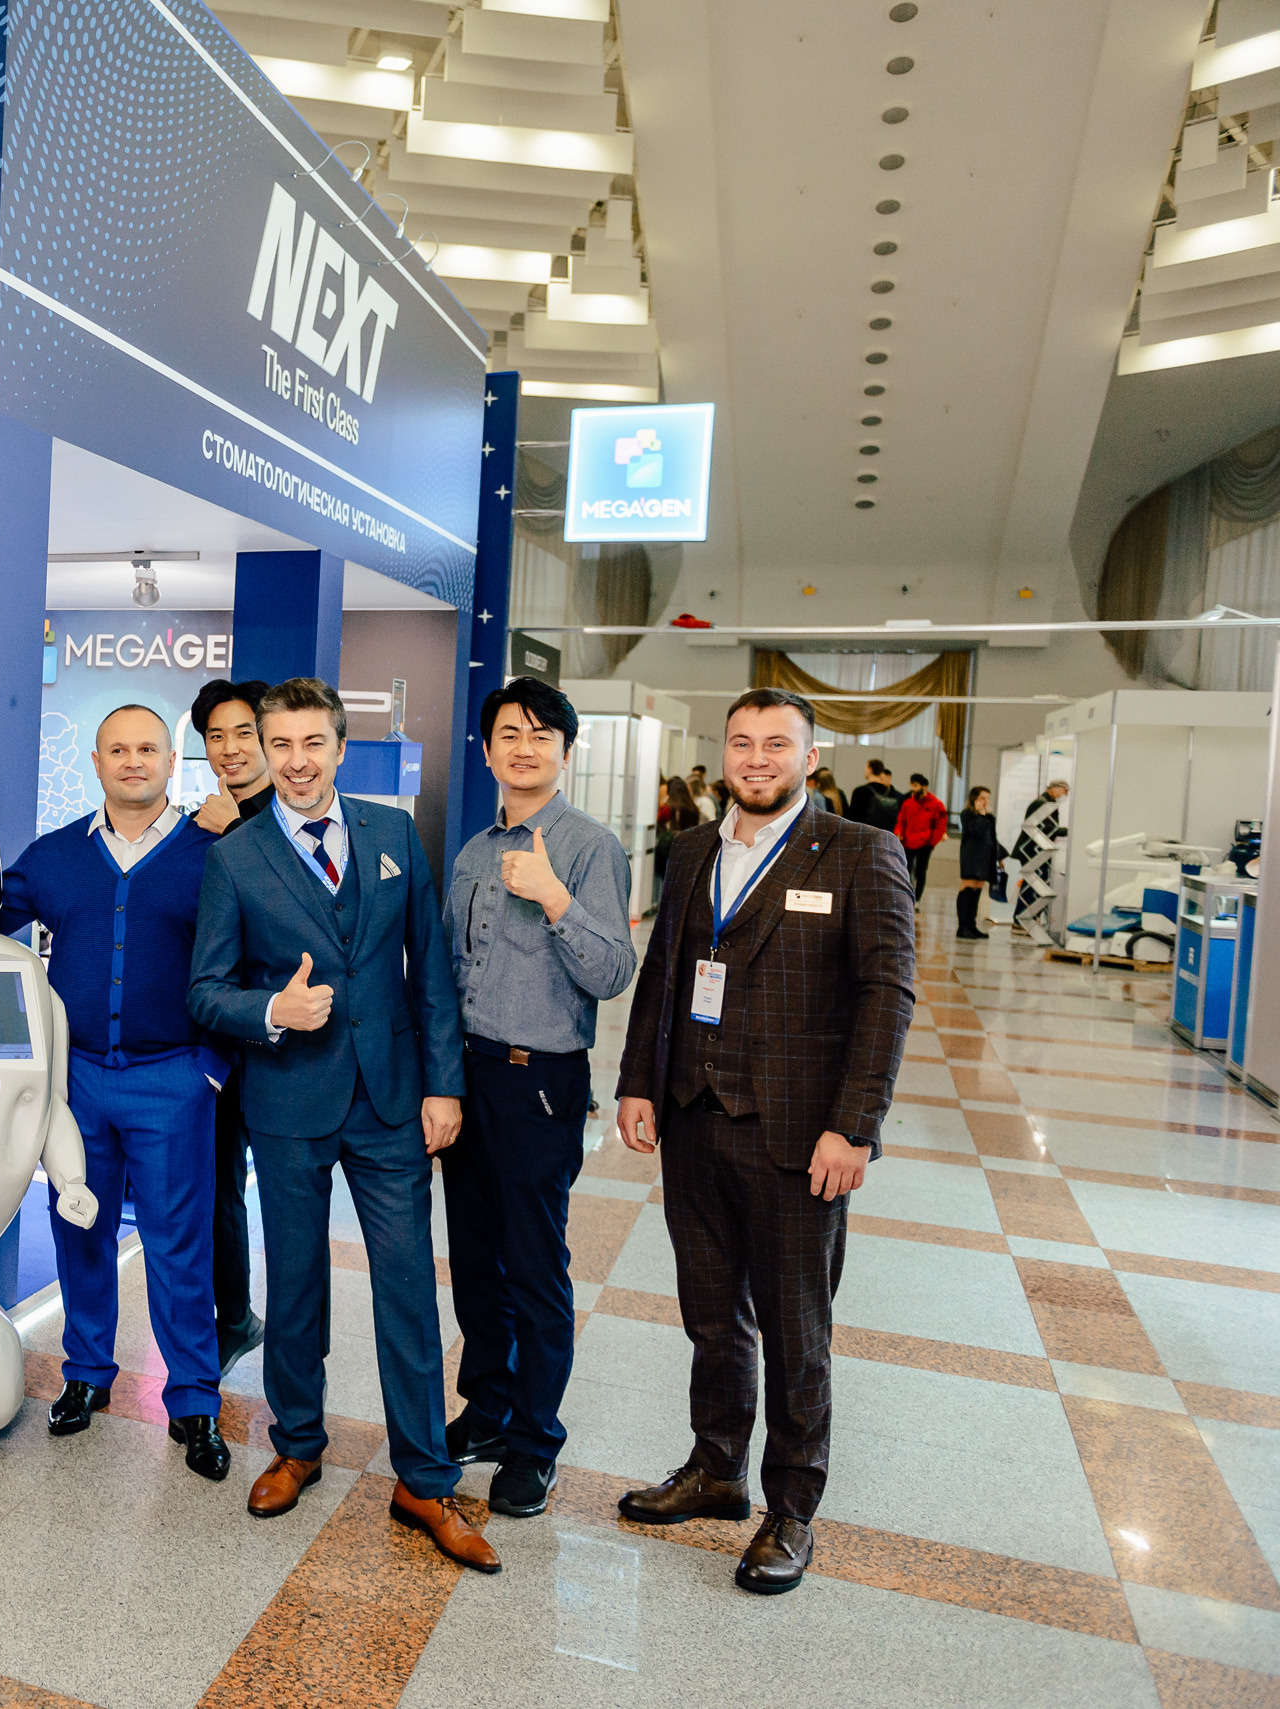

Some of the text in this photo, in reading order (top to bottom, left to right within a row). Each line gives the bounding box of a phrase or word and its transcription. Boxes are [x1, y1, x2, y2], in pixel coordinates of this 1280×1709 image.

[247, 181, 399, 404] NEXT
[262, 344, 360, 446] The First Class
[202, 429, 407, 555] СТОМАТОЛОГИЧЕСКАЯ УСТАНОВКА
